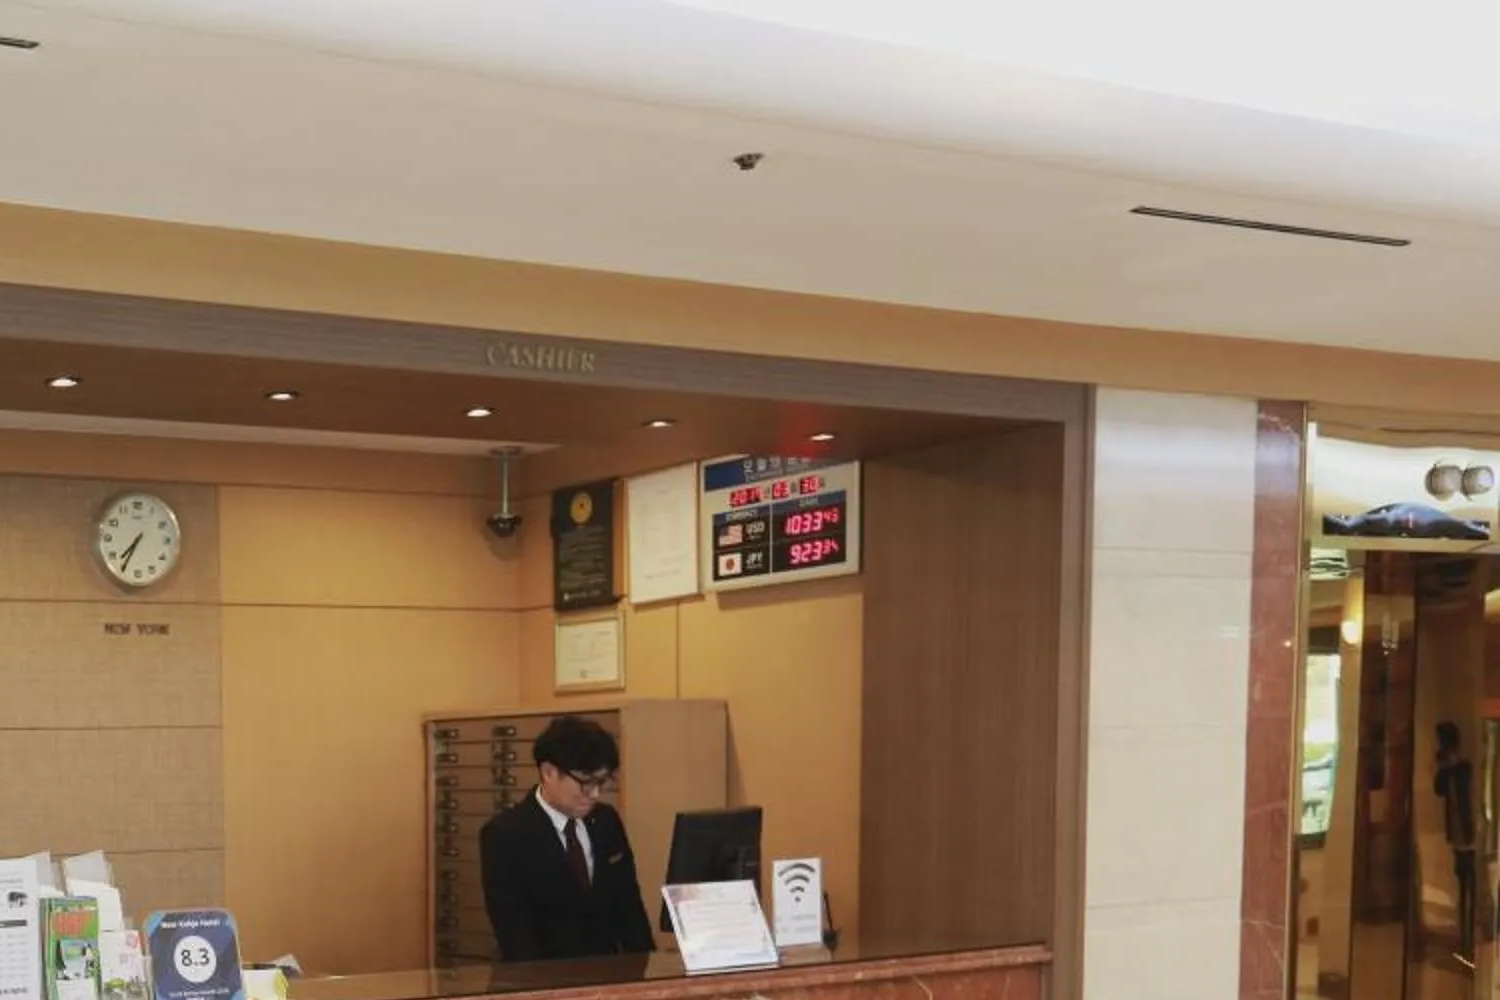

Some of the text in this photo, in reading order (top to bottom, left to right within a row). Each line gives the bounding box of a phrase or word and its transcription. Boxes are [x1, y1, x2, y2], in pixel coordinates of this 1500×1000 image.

[486, 344, 596, 372] CASHIER
[746, 521, 765, 534] USD
[746, 552, 762, 565] JPY
[104, 623, 170, 635] NEW YORK
[181, 948, 210, 967] 8.3
